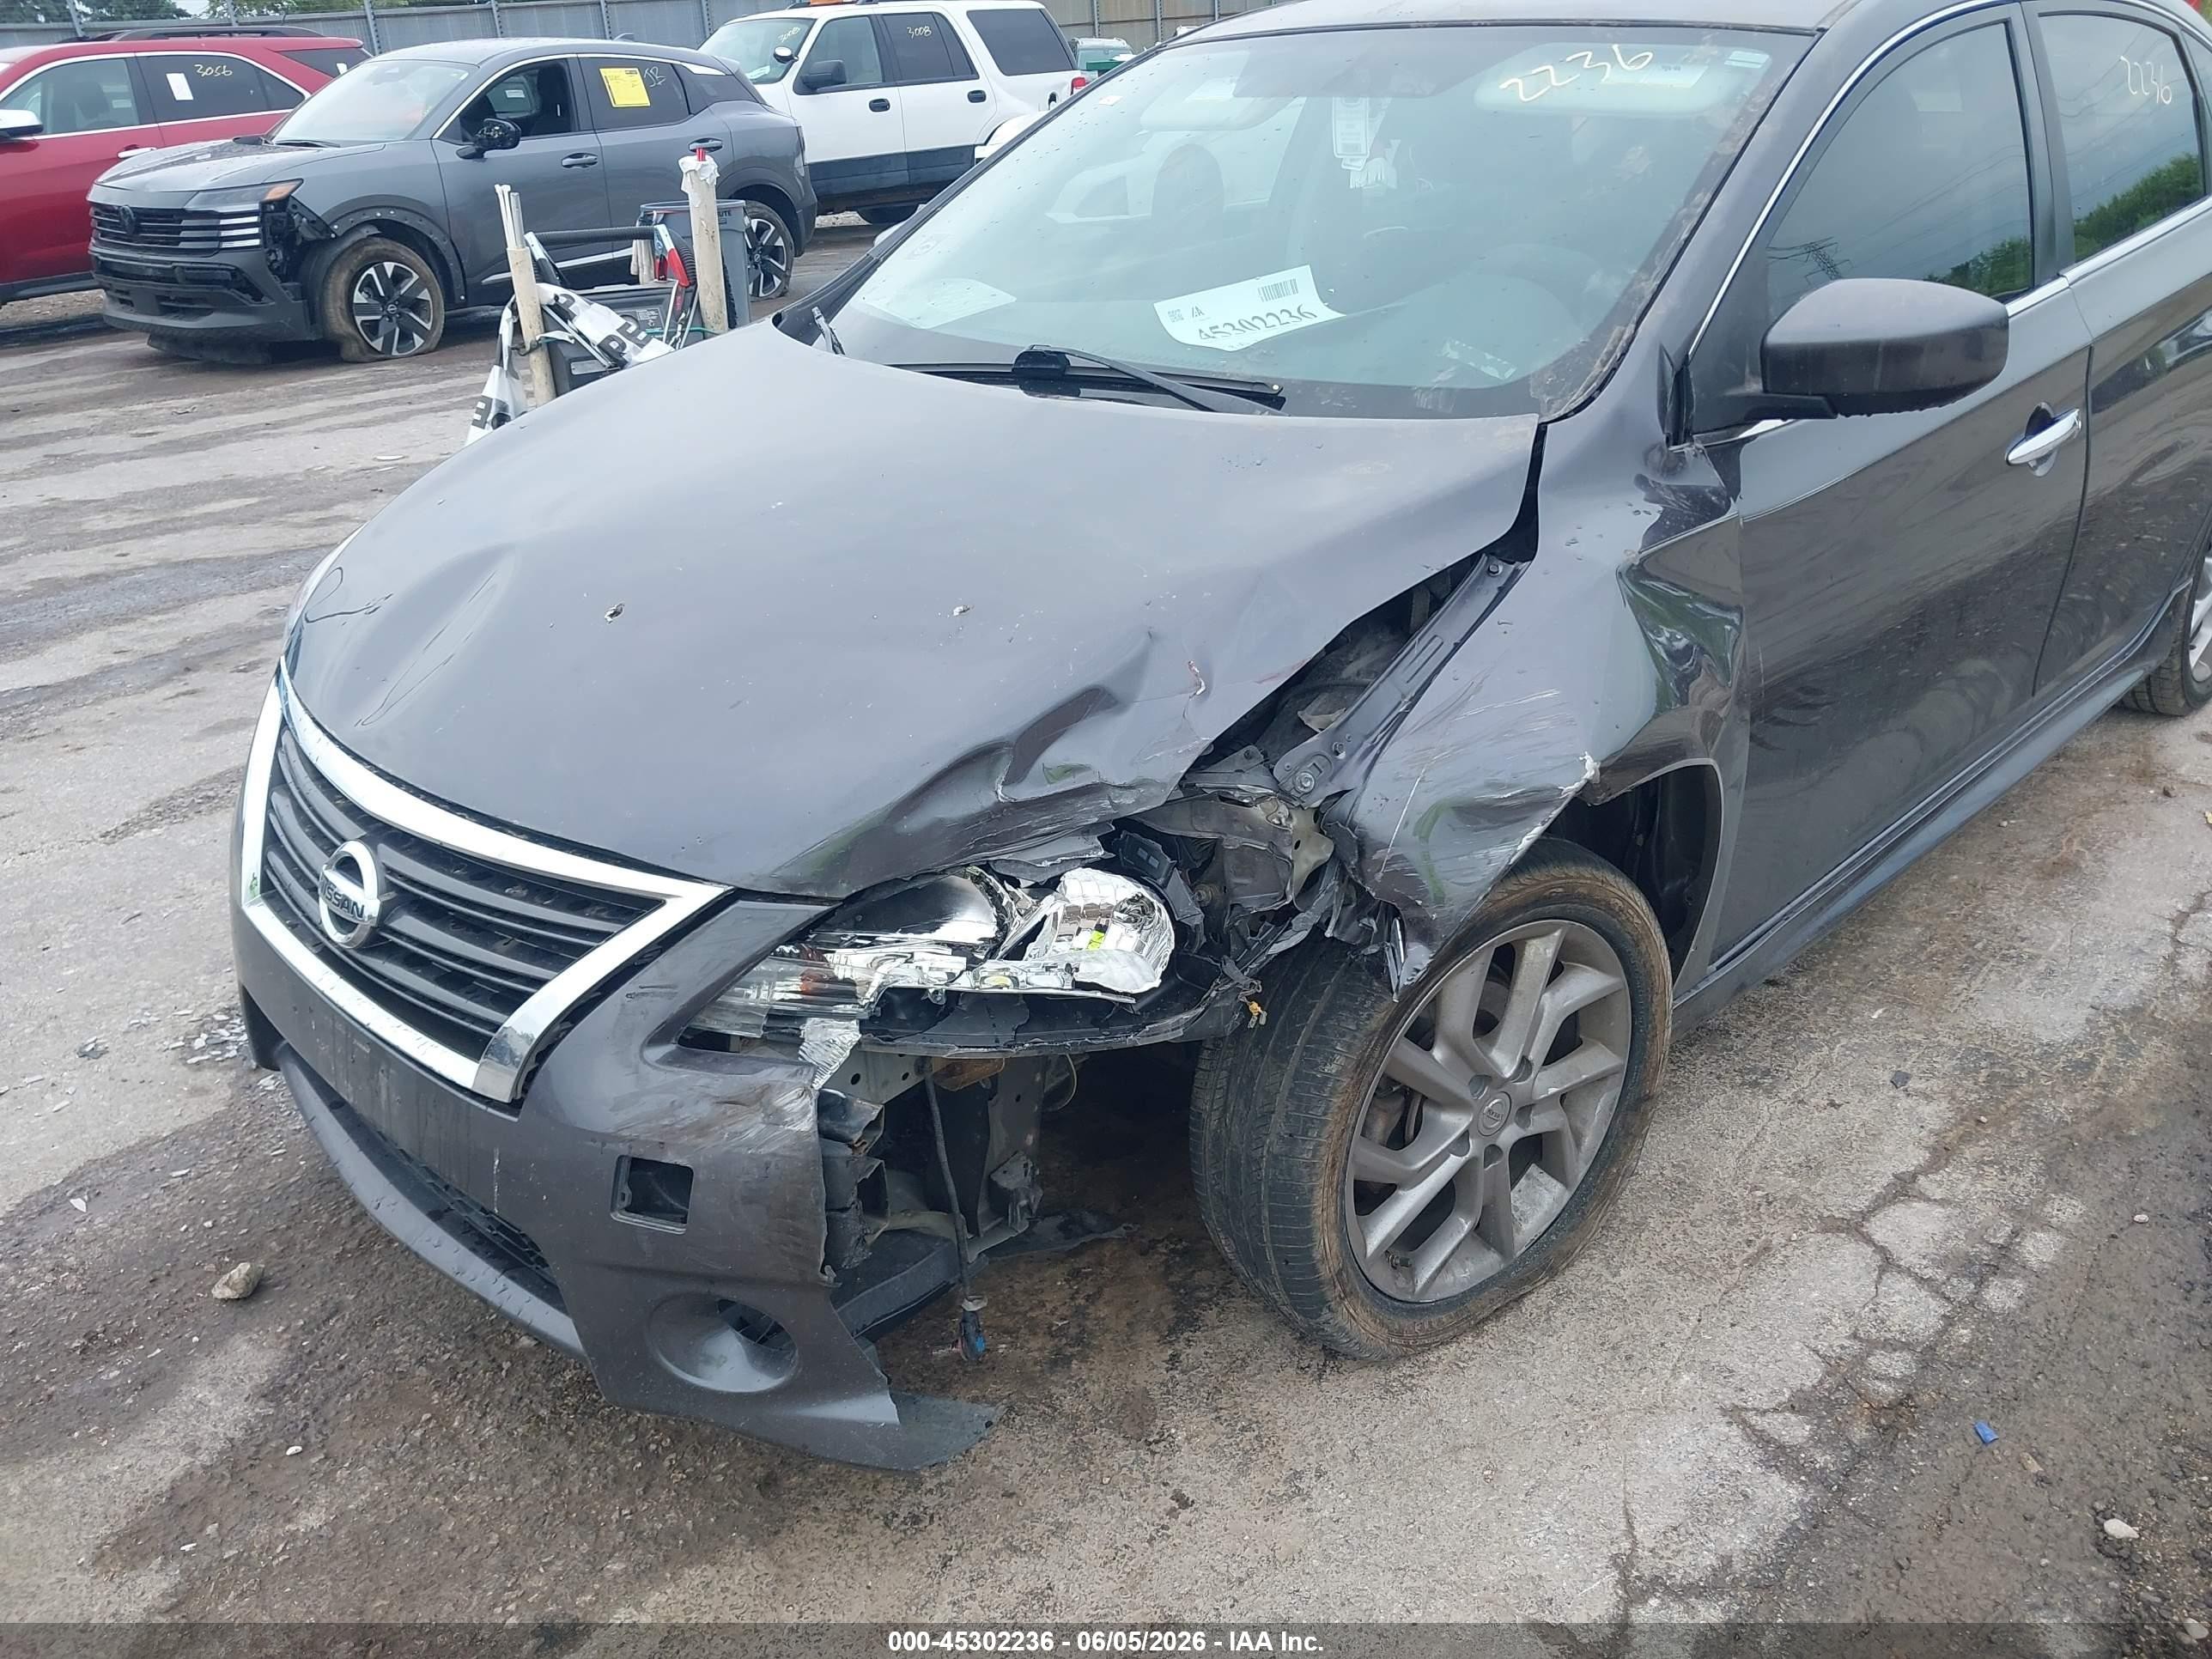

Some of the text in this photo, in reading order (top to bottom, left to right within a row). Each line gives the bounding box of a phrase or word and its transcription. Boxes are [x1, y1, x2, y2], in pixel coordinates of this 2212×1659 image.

[906, 26, 932, 40] 3008
[194, 64, 233, 77] 3056
[1499, 44, 1653, 102] 2236
[2120, 56, 2172, 105] 2236
[1198, 304, 1317, 340] 45302236
